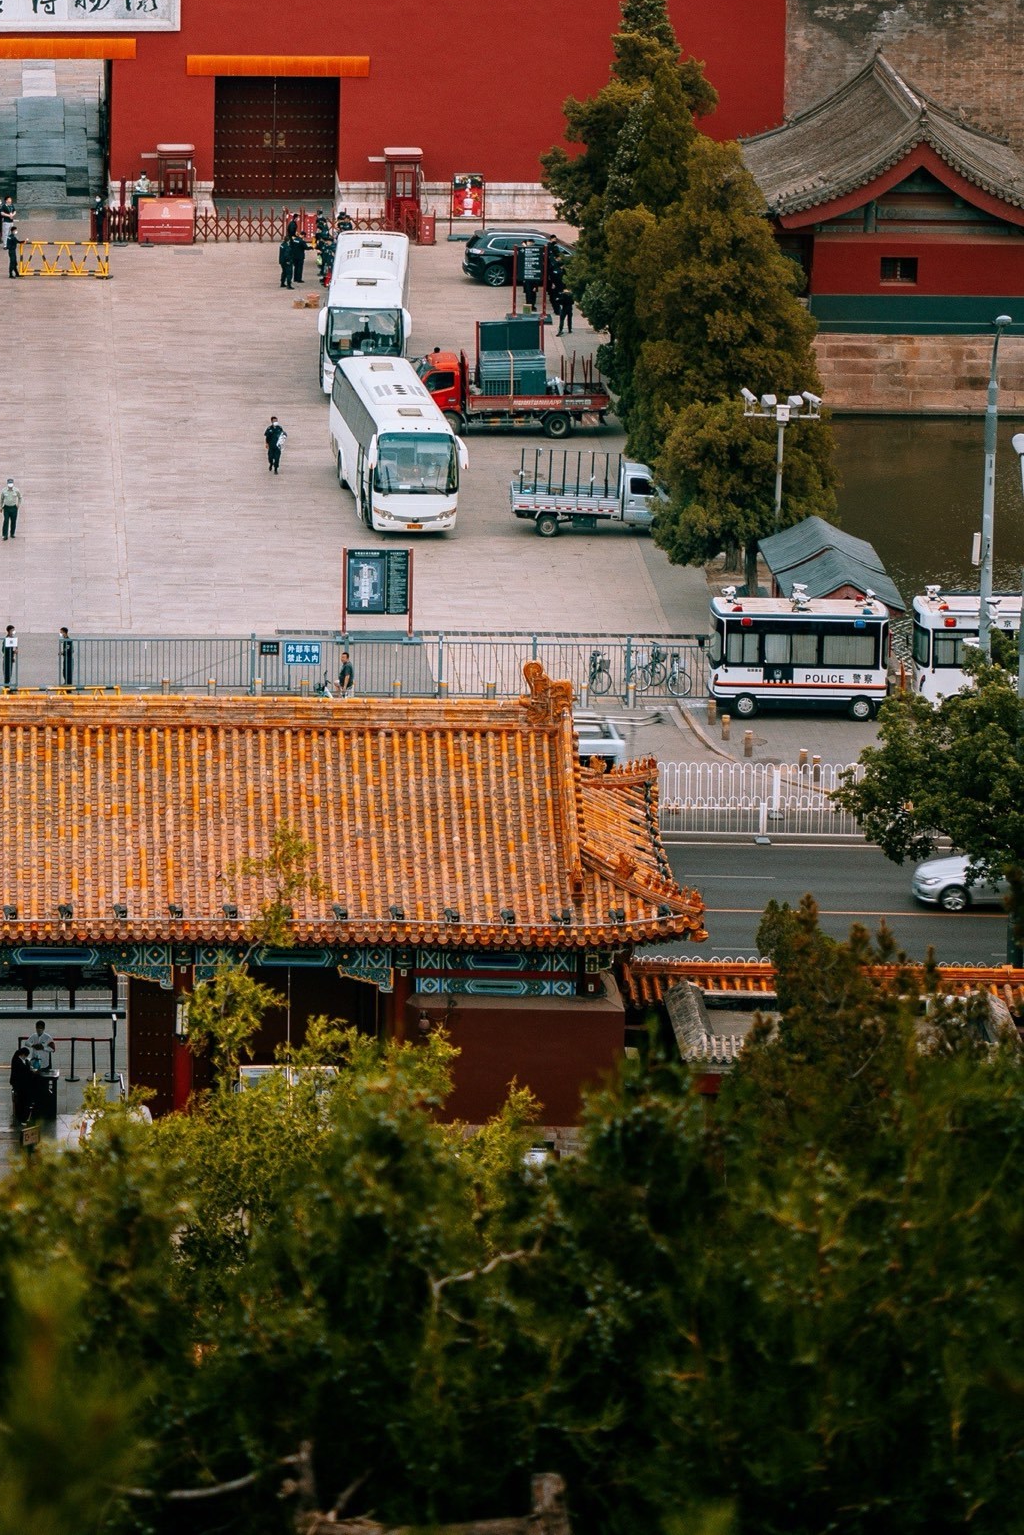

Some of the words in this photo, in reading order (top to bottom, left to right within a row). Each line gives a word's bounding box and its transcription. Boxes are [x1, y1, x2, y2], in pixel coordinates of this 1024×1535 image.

[287, 645, 319, 653] 外部车辆
[287, 654, 319, 663] 禁止入内
[805, 674, 845, 684] POLICE
[852, 673, 873, 684] 警察
